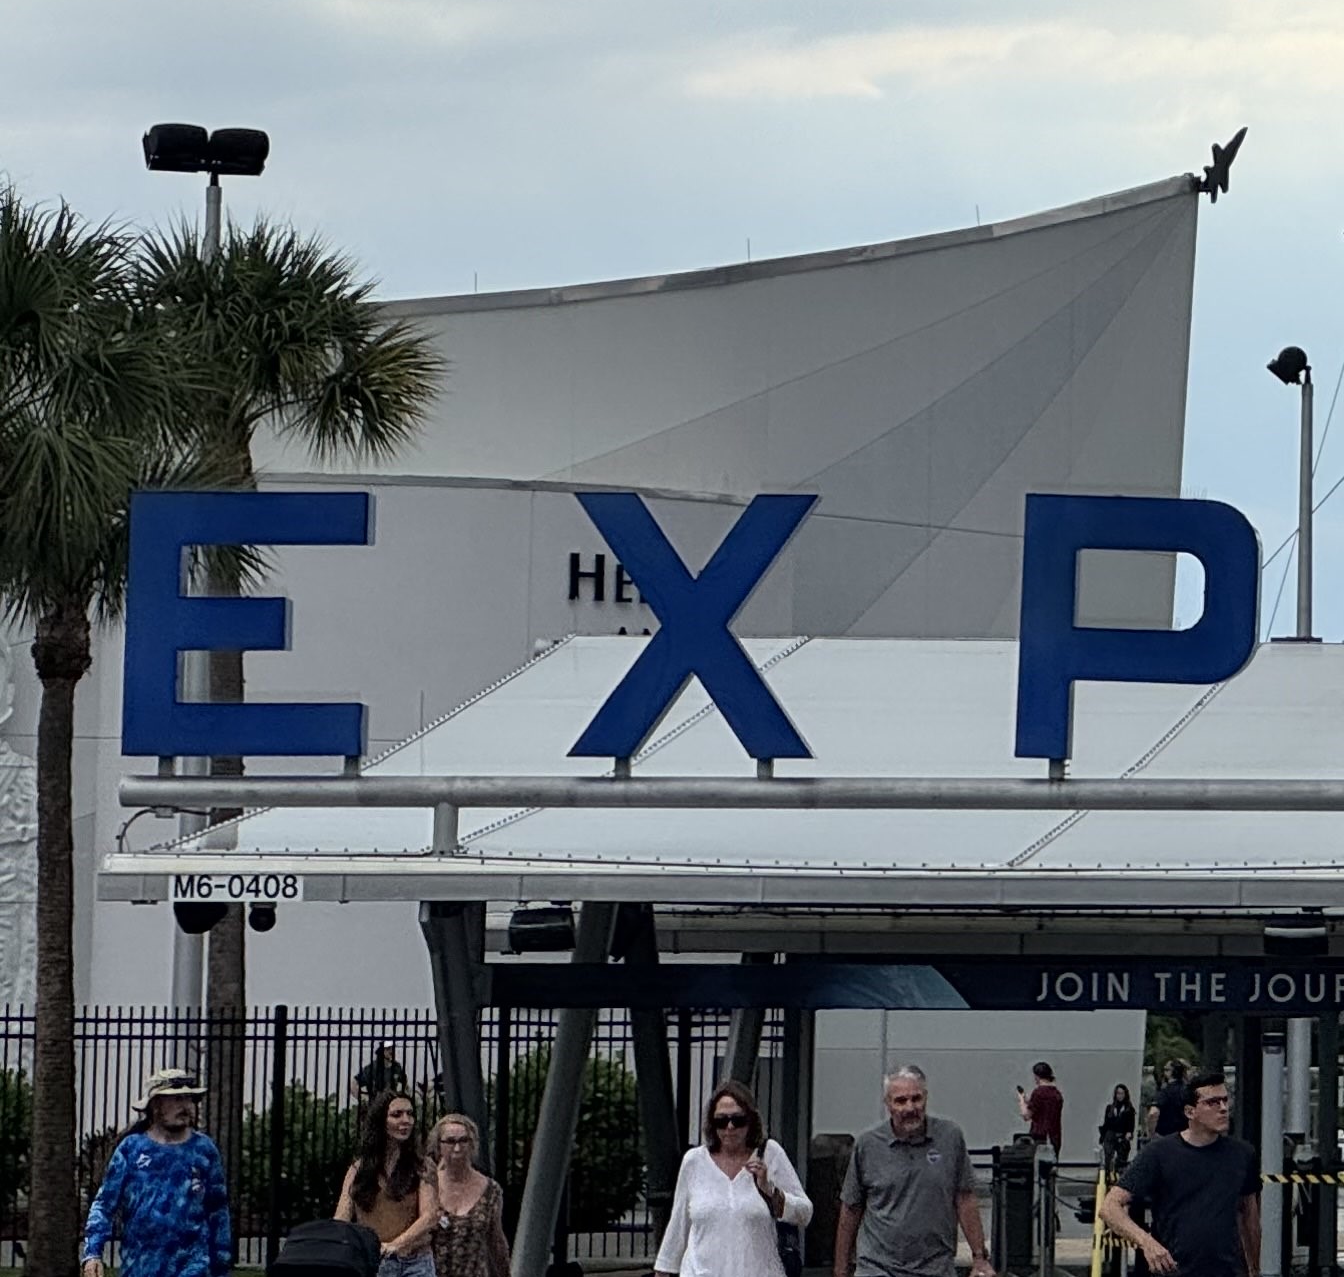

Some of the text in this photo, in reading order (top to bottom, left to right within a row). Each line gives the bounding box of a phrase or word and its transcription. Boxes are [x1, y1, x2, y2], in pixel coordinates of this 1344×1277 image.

[174, 874, 298, 898] M6-0408
[1036, 972, 1130, 1002] JOIN
[1154, 972, 1227, 1002] THE
